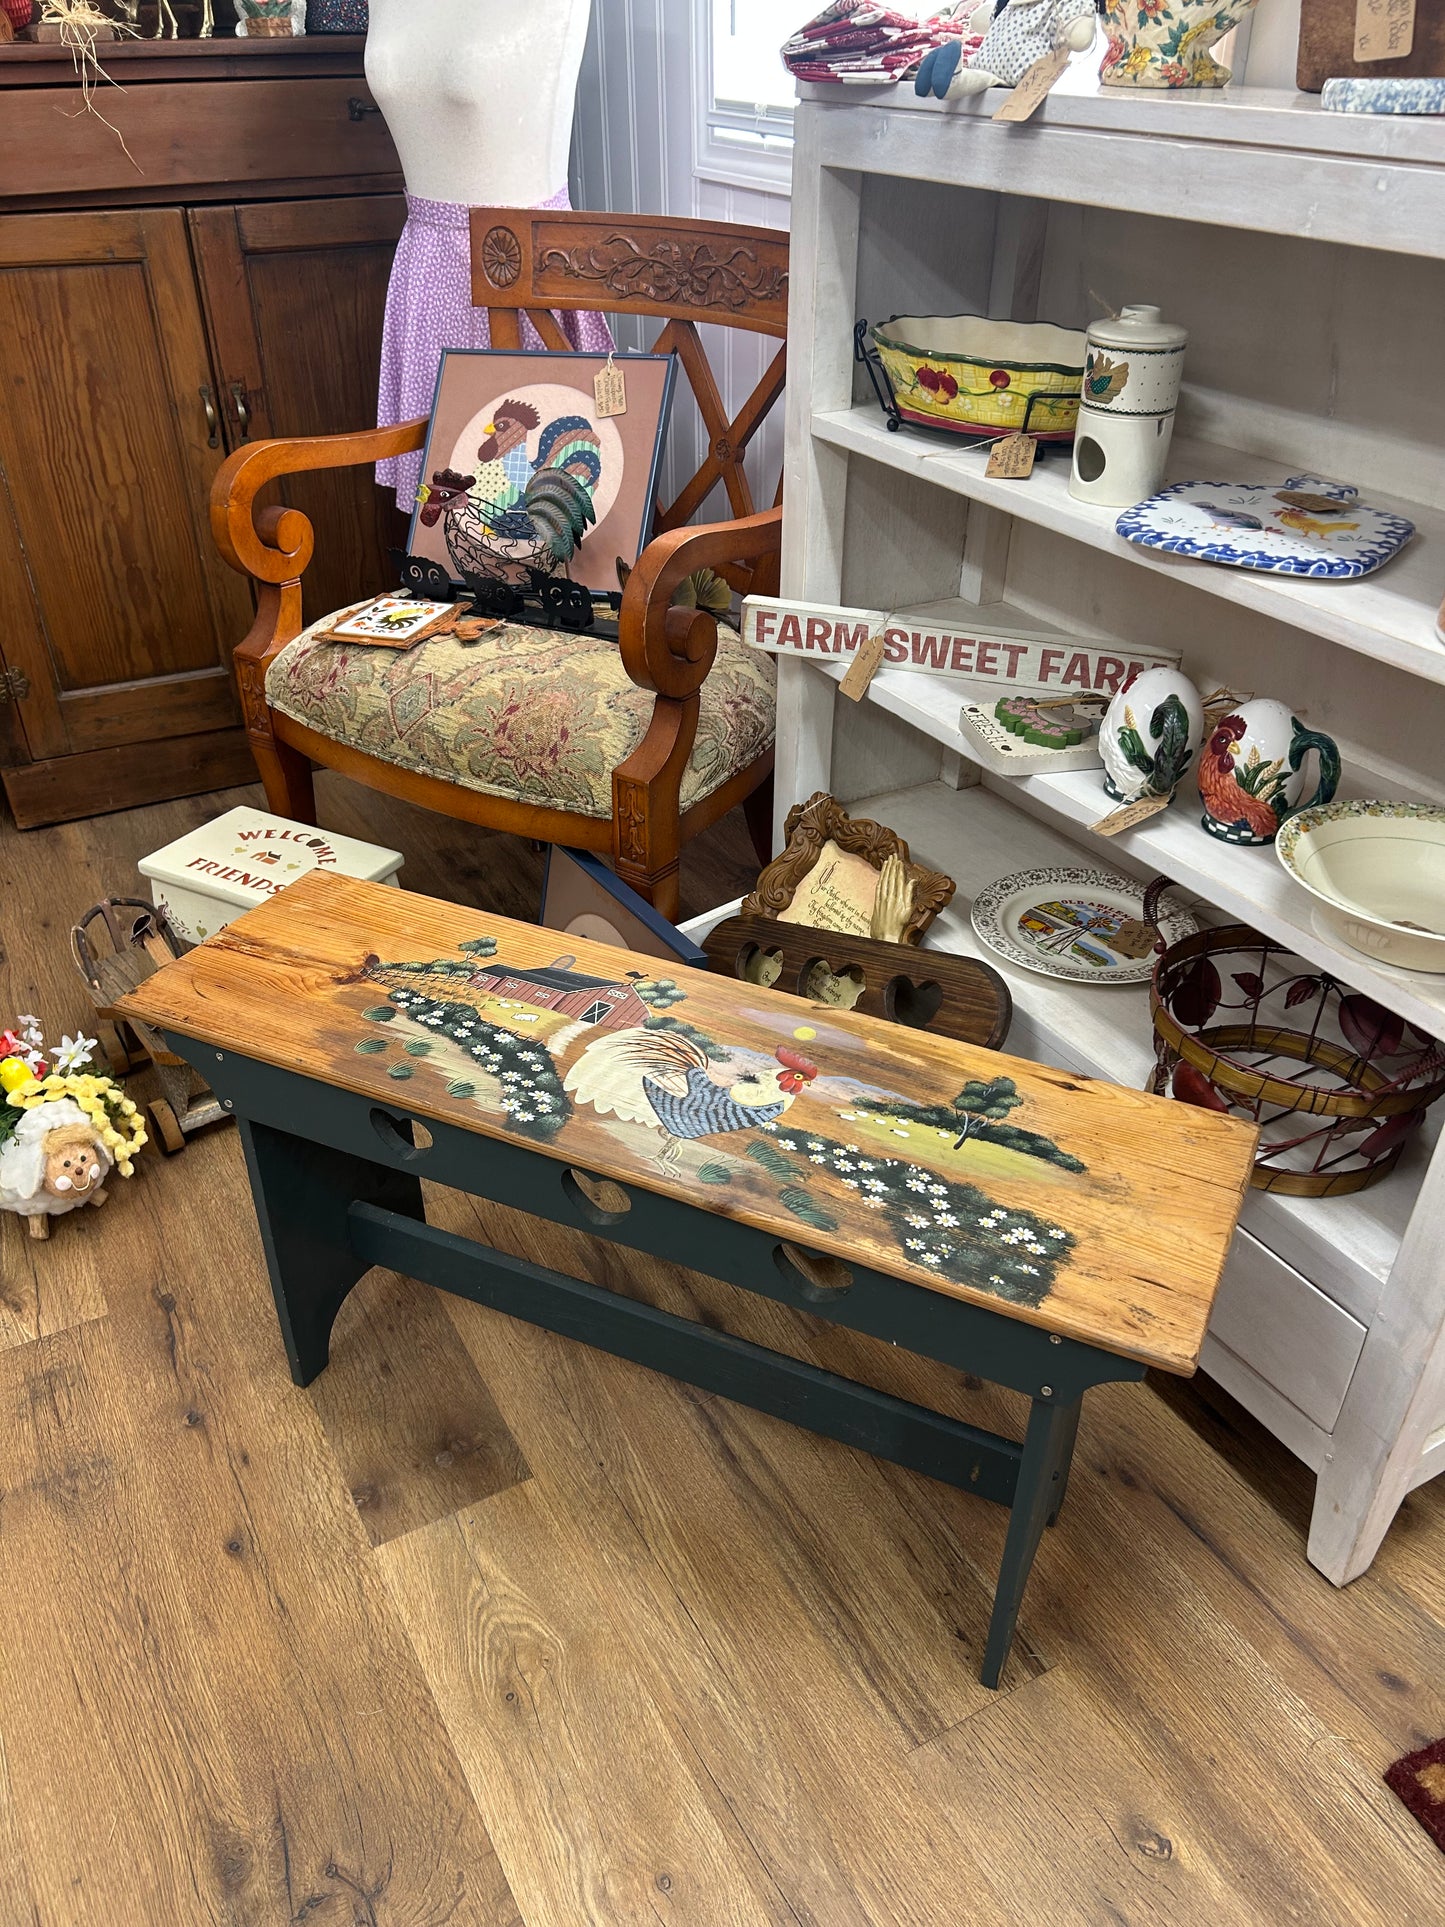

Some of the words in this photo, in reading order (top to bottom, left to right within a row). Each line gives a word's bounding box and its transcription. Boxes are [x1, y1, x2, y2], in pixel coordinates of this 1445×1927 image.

[755, 610, 869, 653] FARM
[883, 628, 1027, 678] SWEET
[968, 713, 1007, 745] FRESH
[238, 829, 337, 866] WELCOME
[185, 857, 288, 895] FRIENDS
